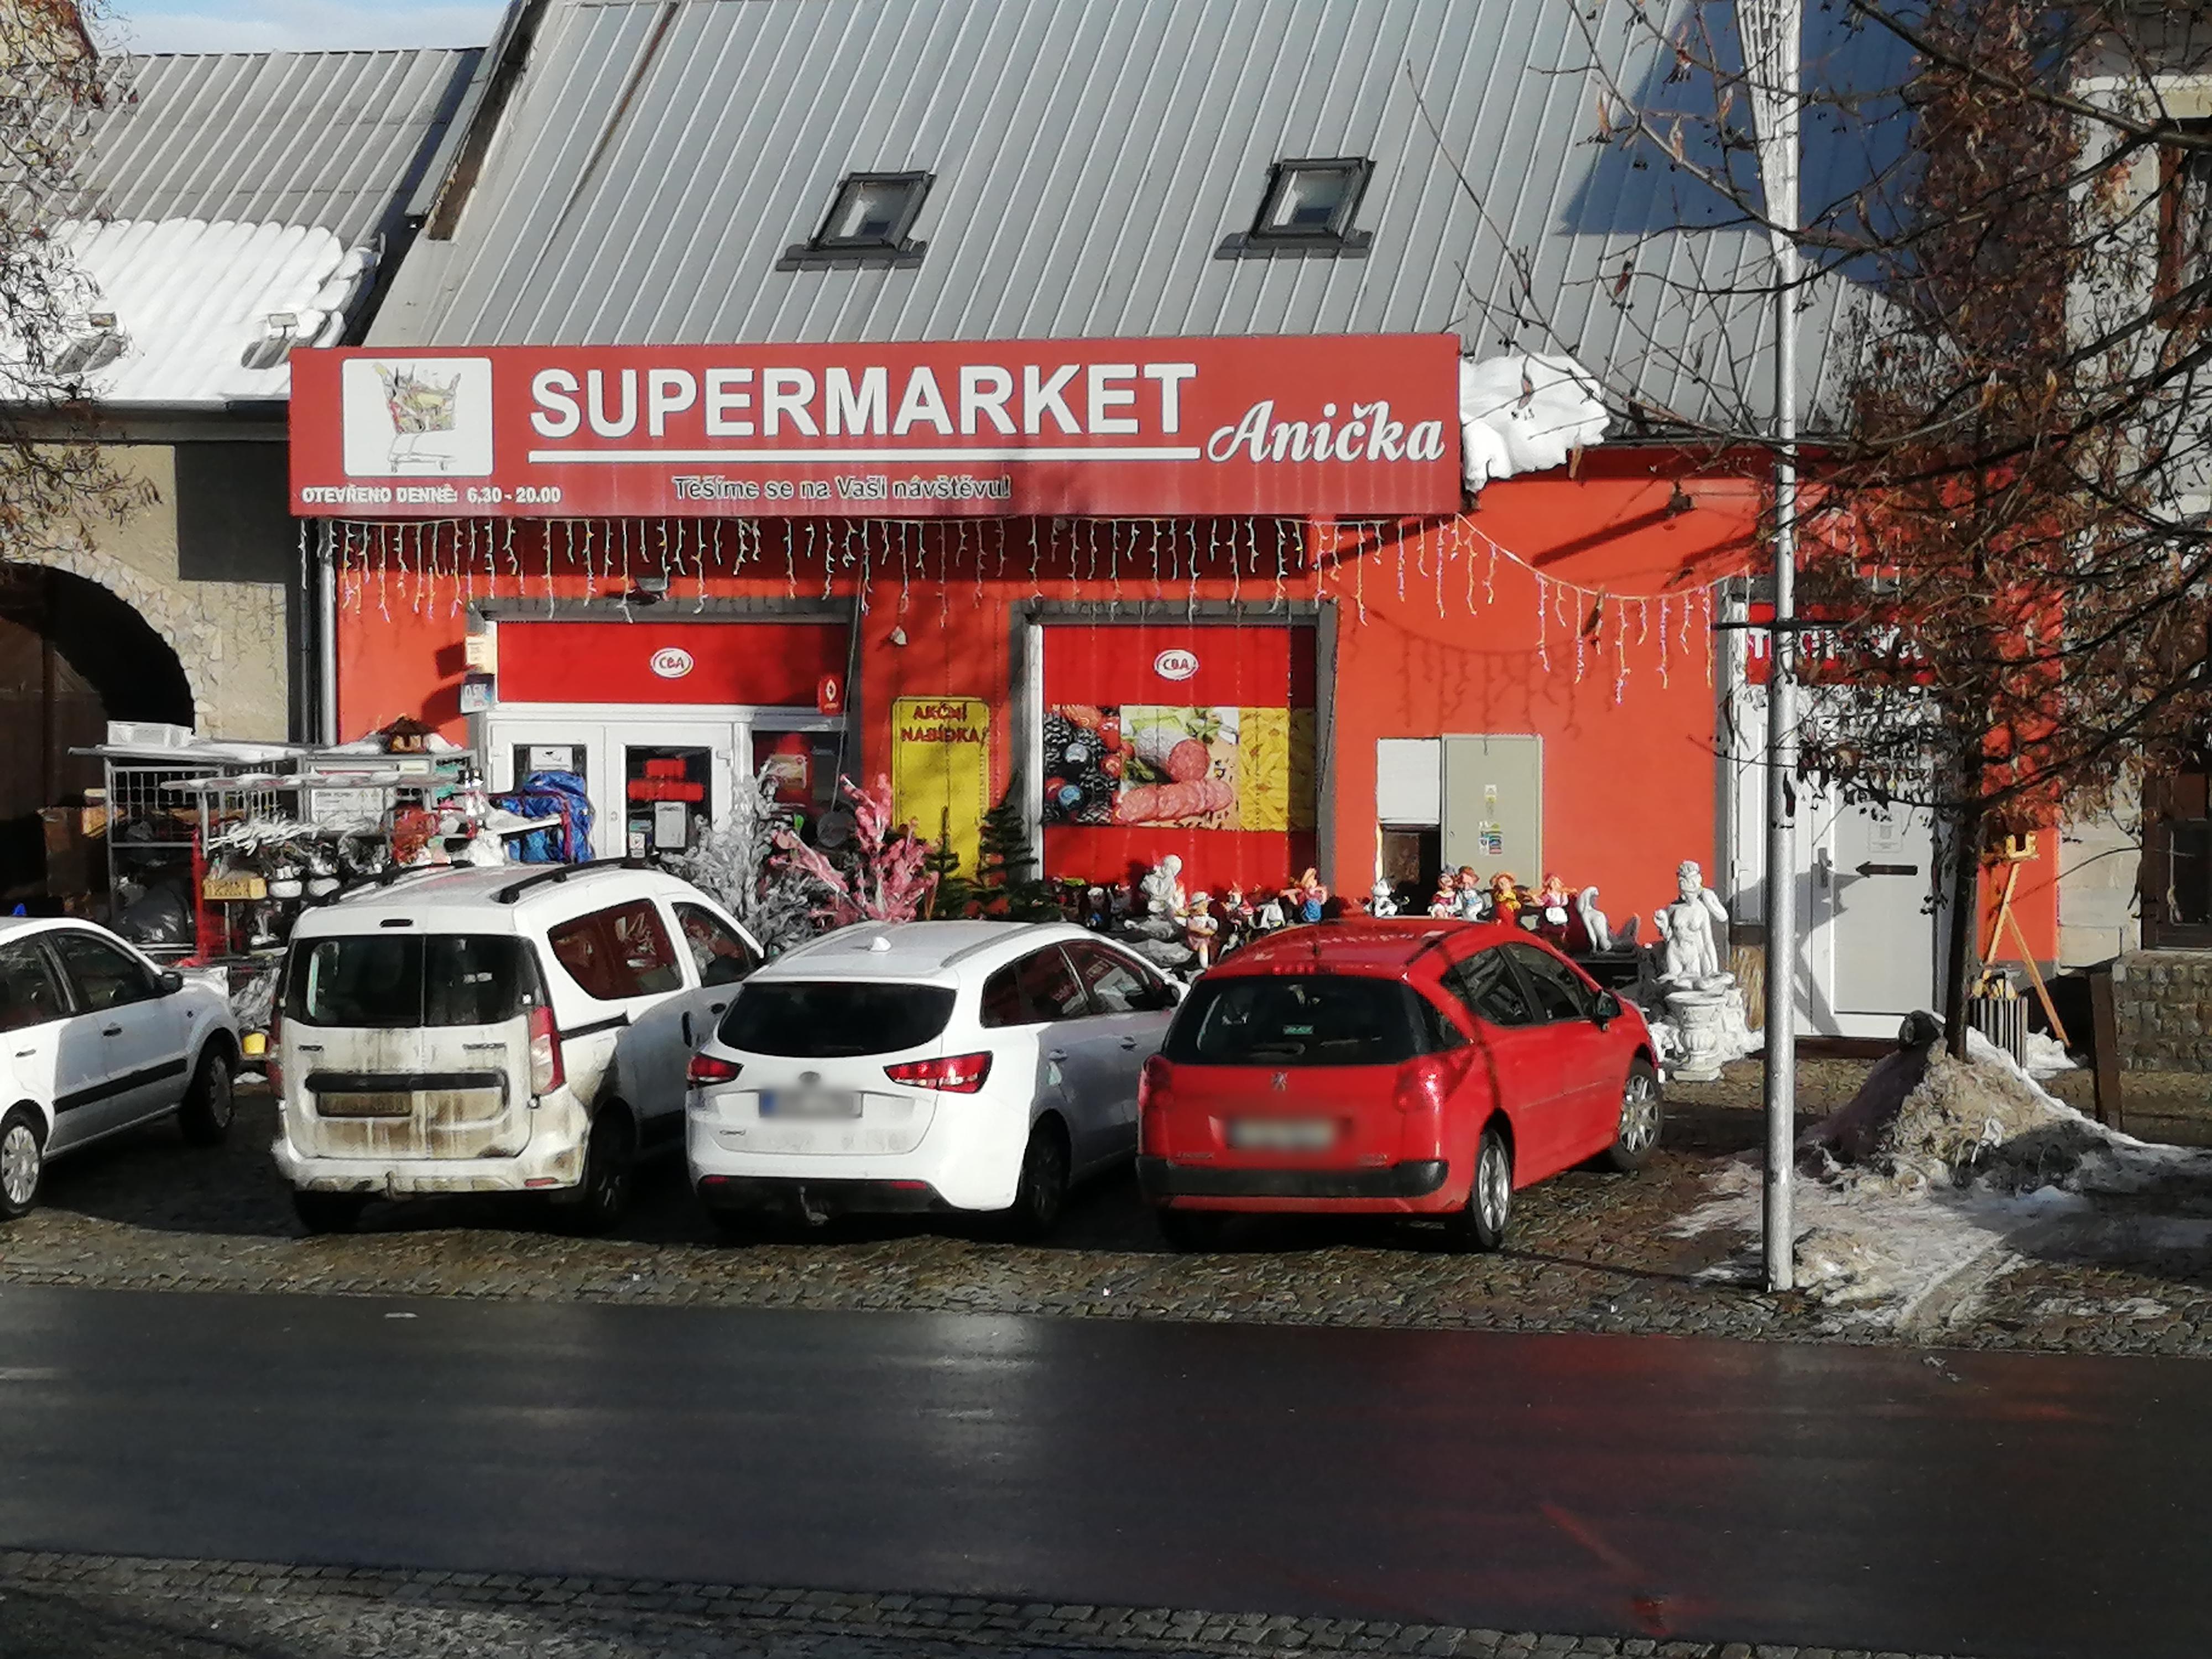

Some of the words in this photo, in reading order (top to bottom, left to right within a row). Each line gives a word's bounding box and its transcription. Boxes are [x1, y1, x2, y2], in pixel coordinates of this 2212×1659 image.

[529, 362, 1197, 438] SUPERMARKET
[1207, 399, 1446, 463] Anička
[302, 483, 393, 503] OTEVŘENO
[515, 486, 562, 504] 20.00
[671, 474, 760, 500] Těšíme
[764, 480, 794, 500] se
[800, 480, 832, 500] na
[893, 474, 1011, 499] návštěvu!
